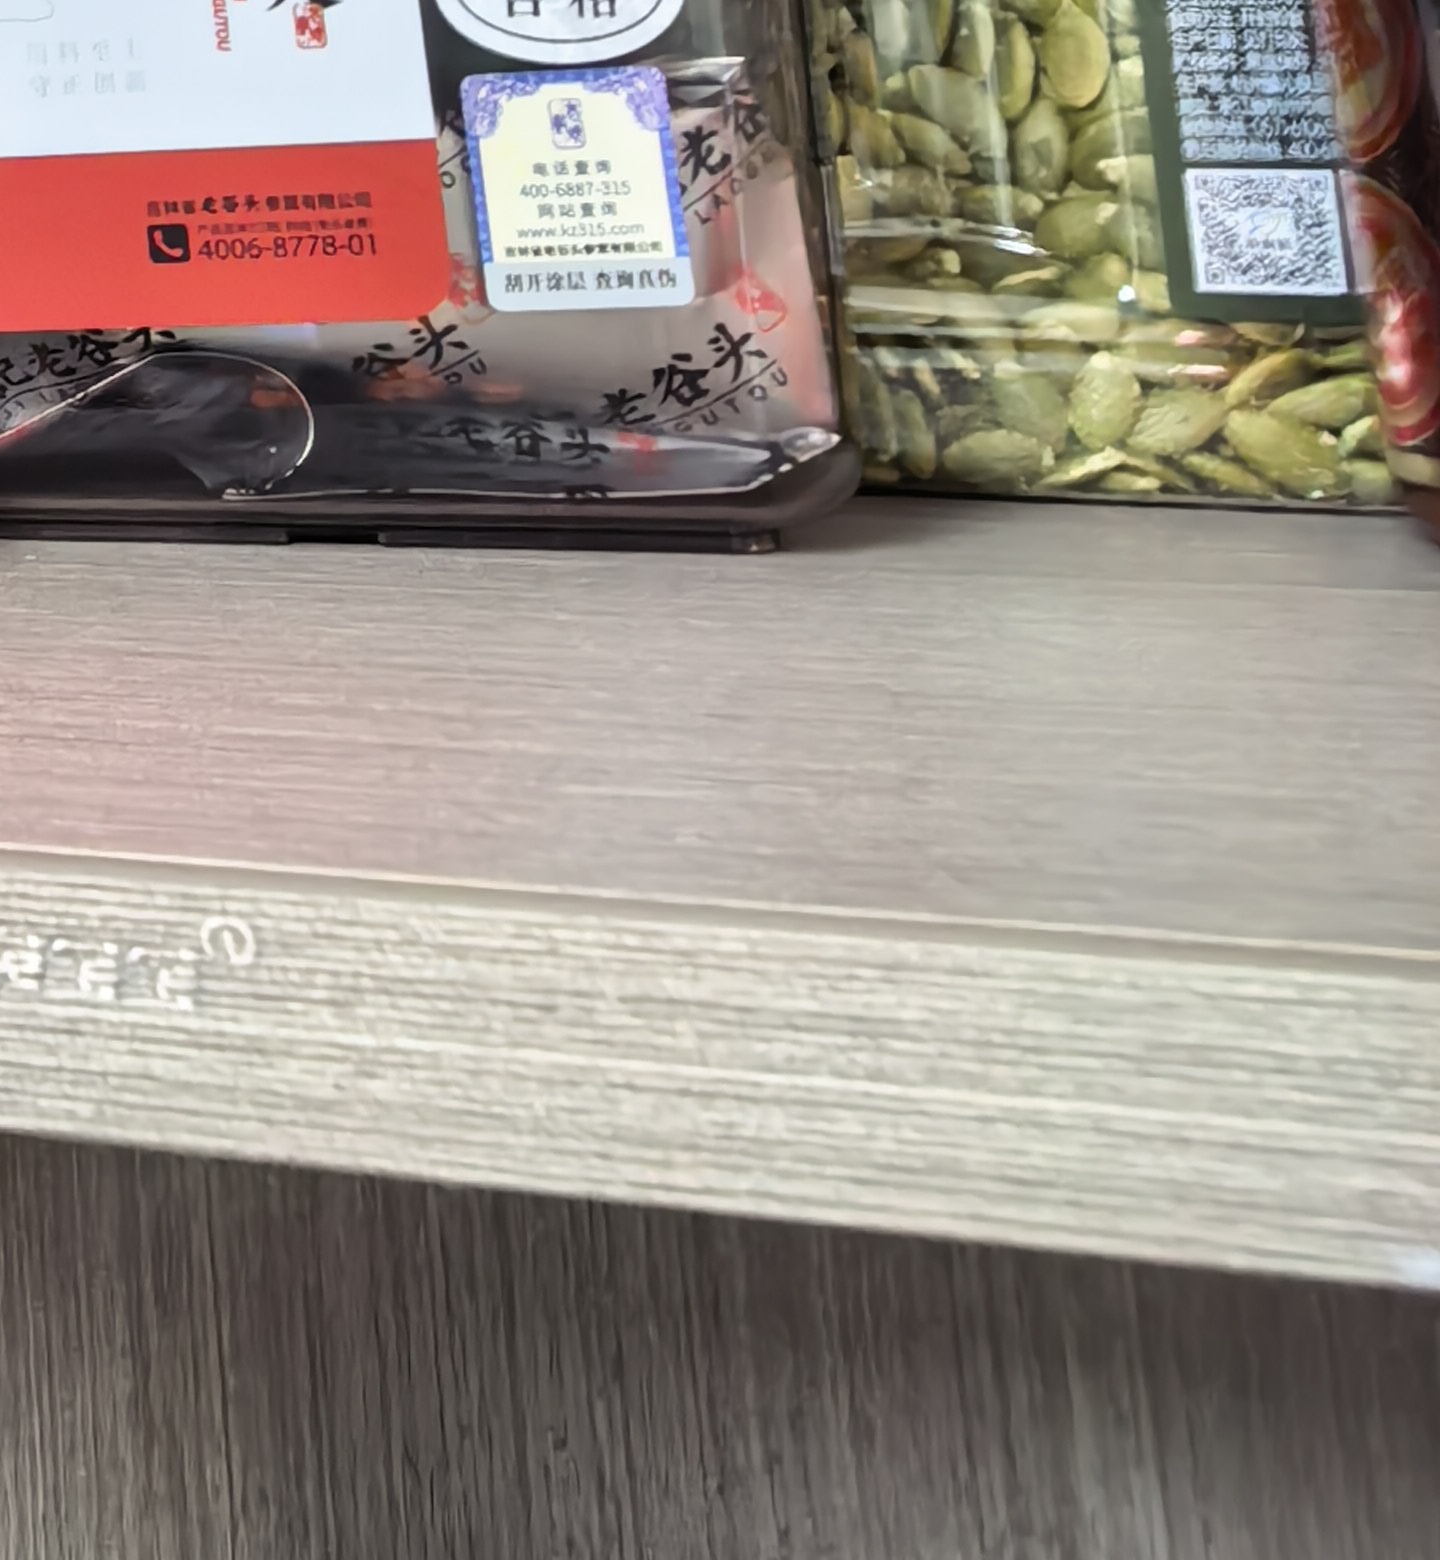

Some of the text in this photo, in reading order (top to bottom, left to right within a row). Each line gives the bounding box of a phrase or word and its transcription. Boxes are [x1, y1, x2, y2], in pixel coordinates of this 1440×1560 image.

[519, 179, 632, 199] 400-6887-315
[196, 233, 378, 261] 4006-8778-01
[504, 271, 588, 295] 刮开涂层
